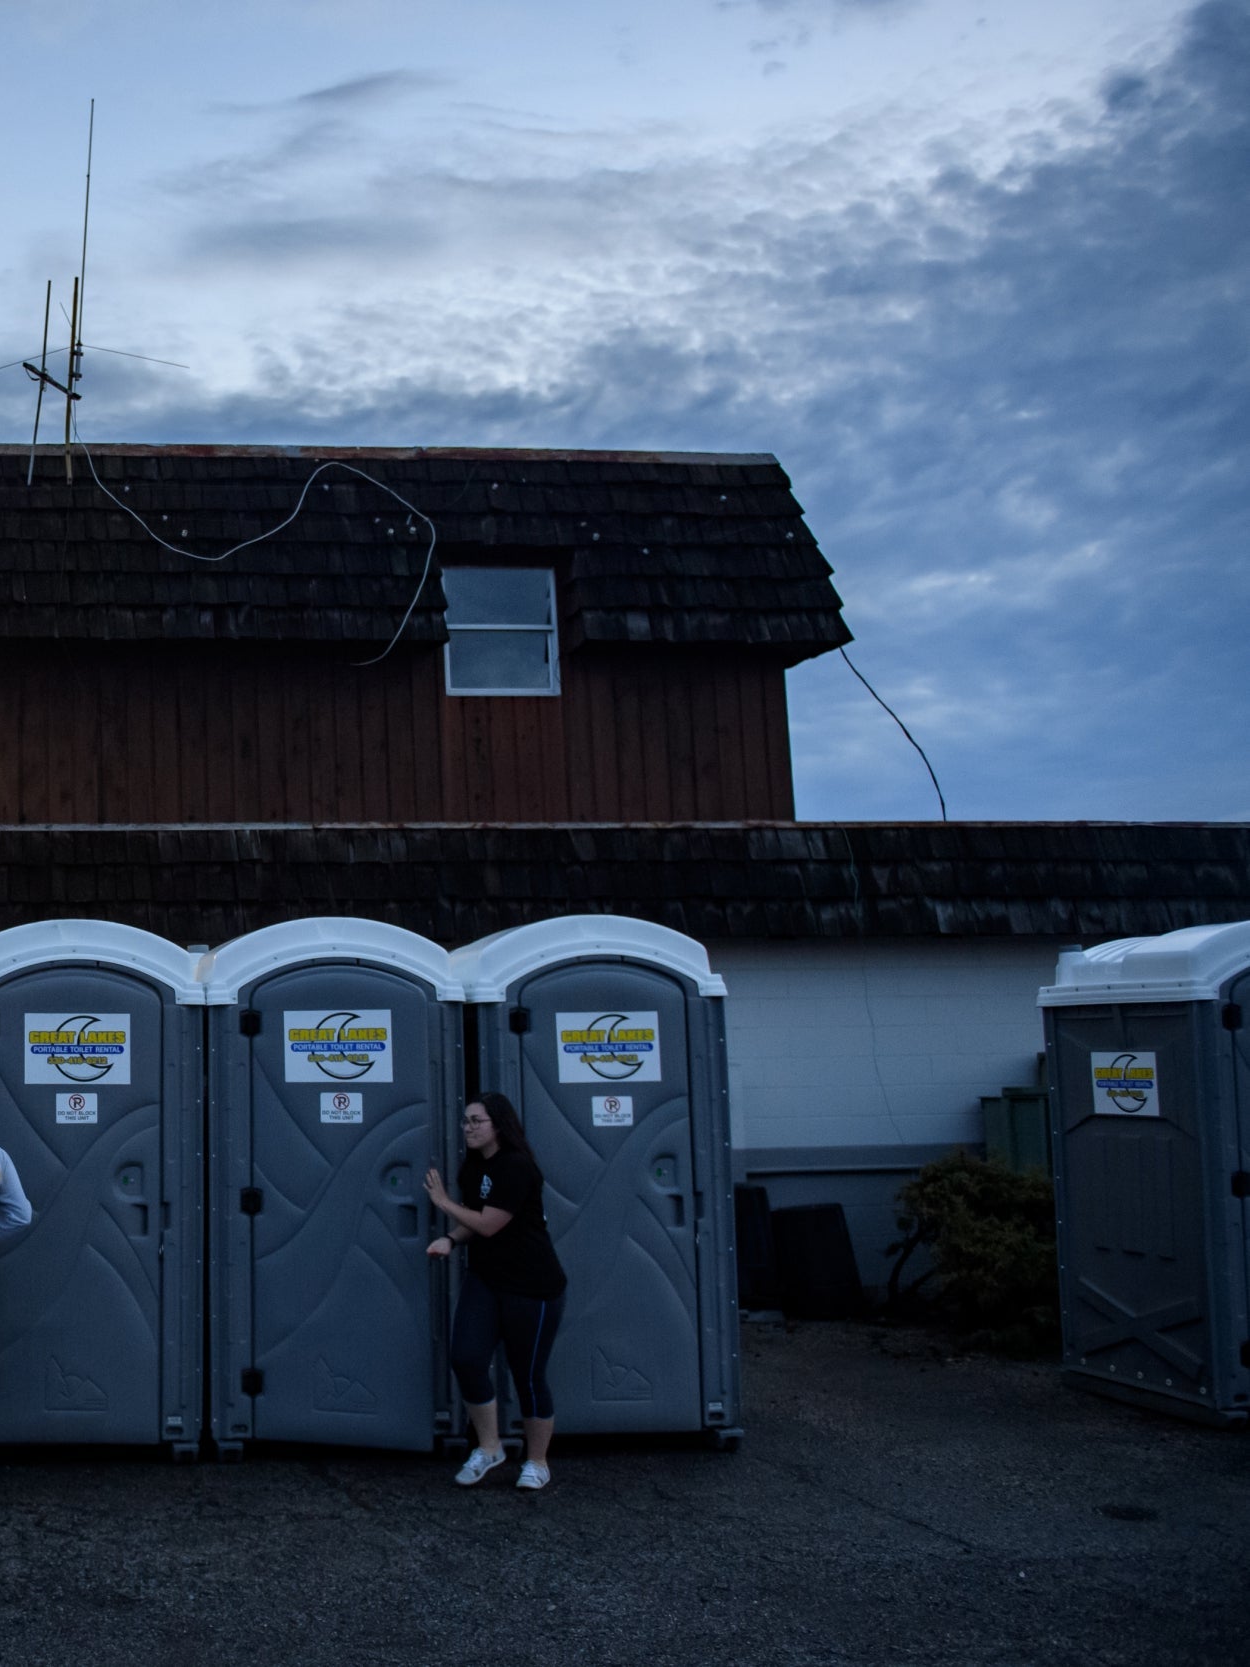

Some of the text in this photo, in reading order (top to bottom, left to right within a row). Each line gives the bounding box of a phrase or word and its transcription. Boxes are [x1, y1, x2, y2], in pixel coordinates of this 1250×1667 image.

[29, 1031, 126, 1044] GREAT LAKES
[289, 1028, 387, 1041] GREAT LAKES
[561, 1029, 654, 1042] GREAT LAKES
